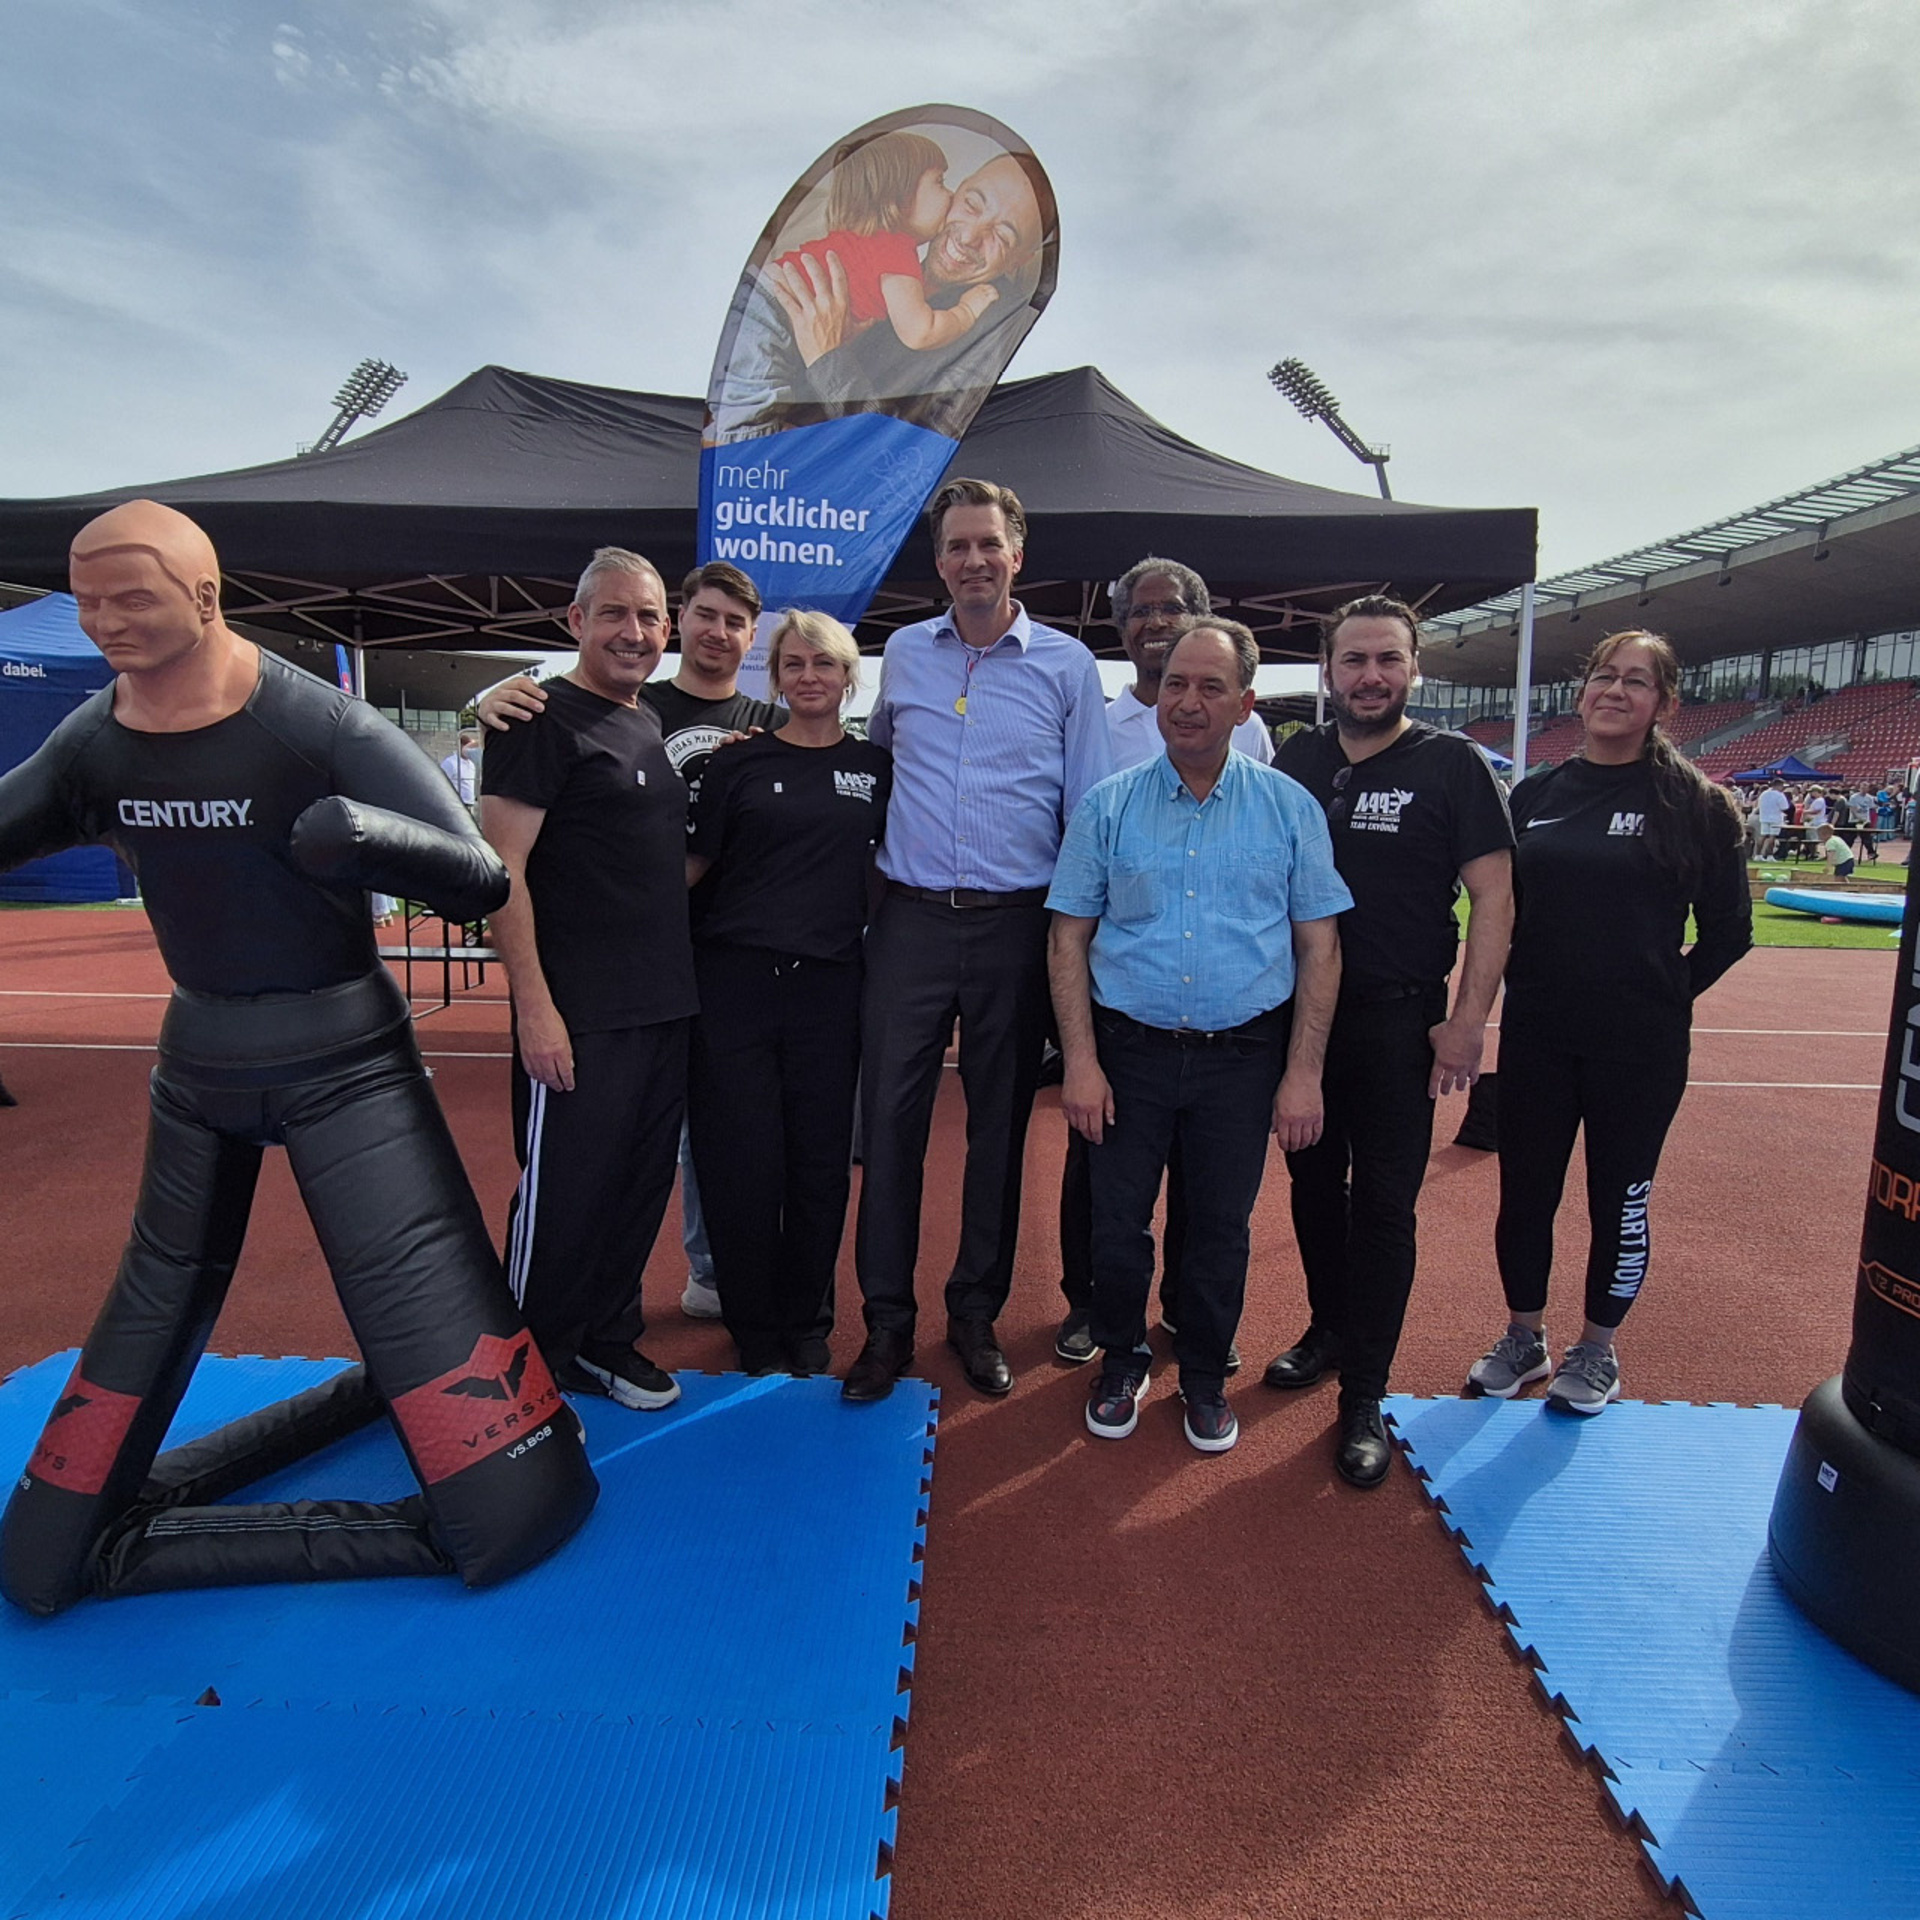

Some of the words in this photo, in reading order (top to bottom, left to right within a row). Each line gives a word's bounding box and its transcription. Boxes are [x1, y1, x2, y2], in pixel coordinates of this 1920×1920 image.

[718, 460, 790, 490] mehr
[716, 496, 870, 532] gücklicher
[714, 532, 844, 567] wohnen.
[2, 661, 48, 678] dabei.
[117, 798, 255, 829] CENTURY.
[1620, 1179, 1651, 1248] START
[1607, 1250, 1647, 1299] NOW
[461, 1386, 558, 1449] VERSYS
[506, 1424, 553, 1460] VS.BOB
